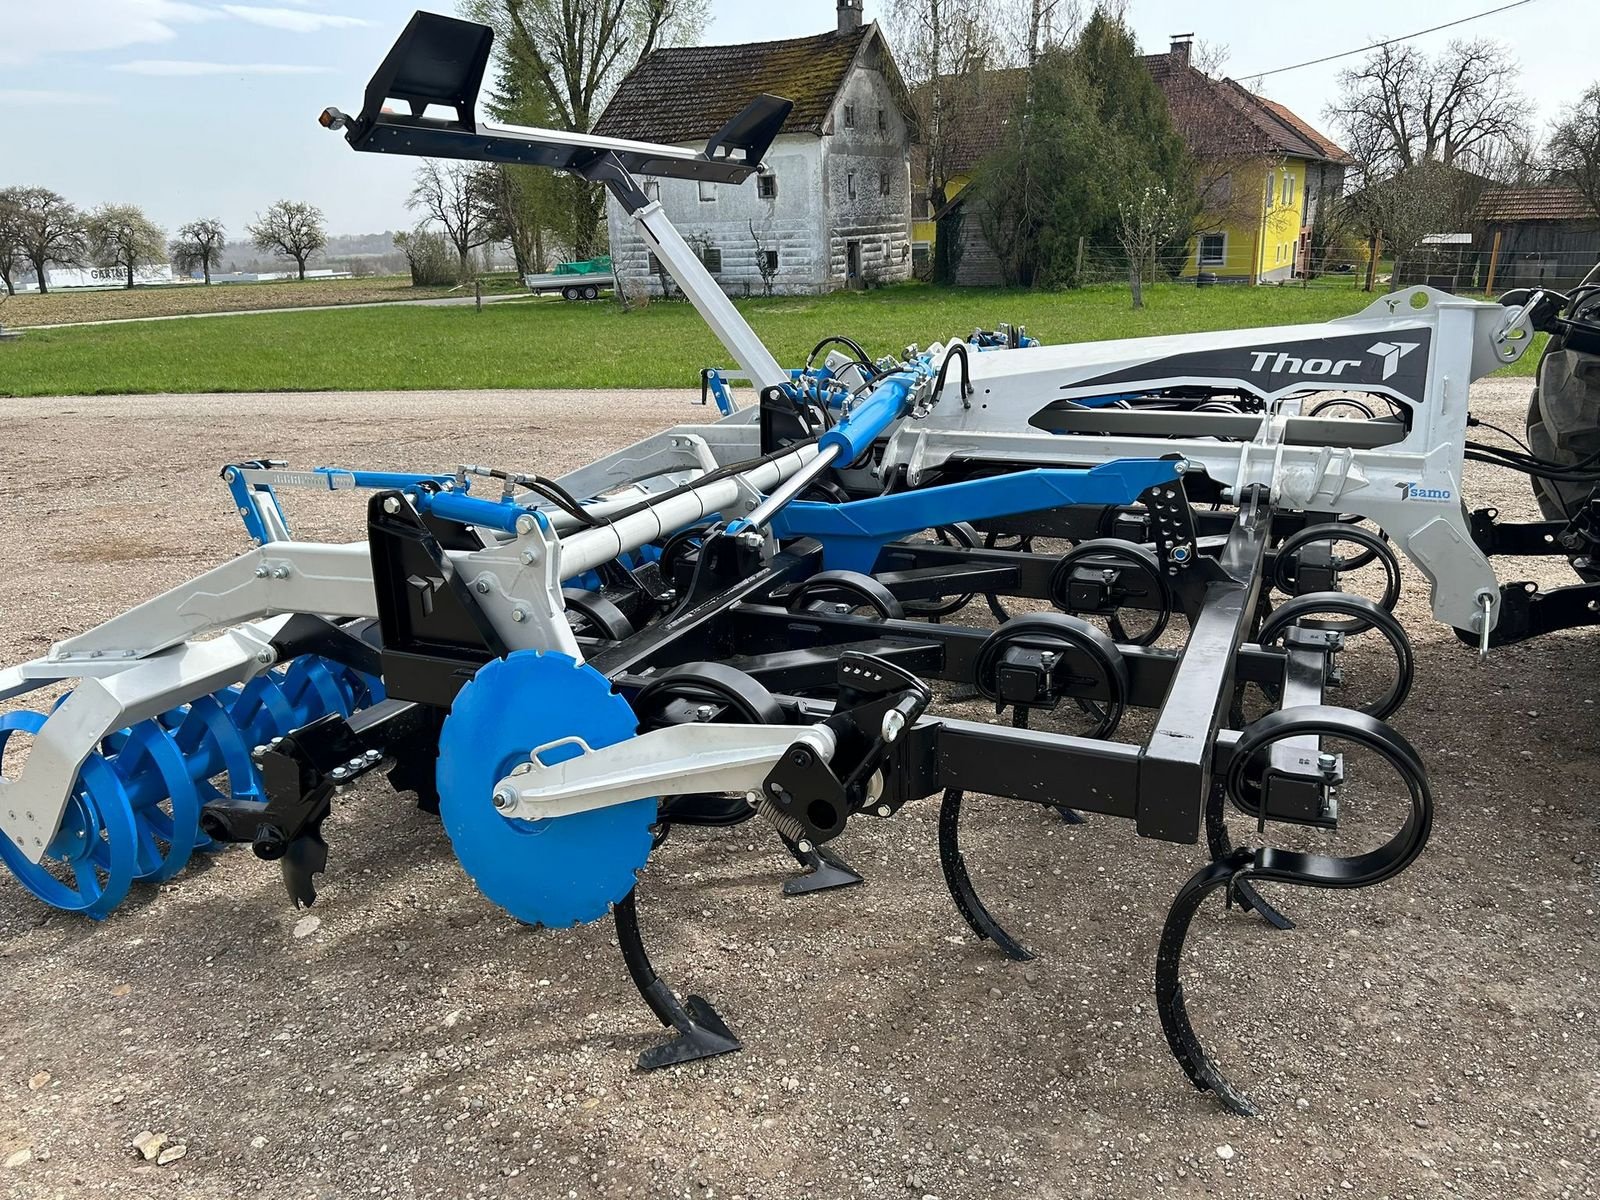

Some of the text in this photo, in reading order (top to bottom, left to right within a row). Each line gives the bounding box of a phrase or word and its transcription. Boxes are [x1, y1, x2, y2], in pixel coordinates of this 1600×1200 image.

[91, 268, 134, 279] GARTNE
[1250, 352, 1362, 375] Thor
[1410, 489, 1450, 498] samo
